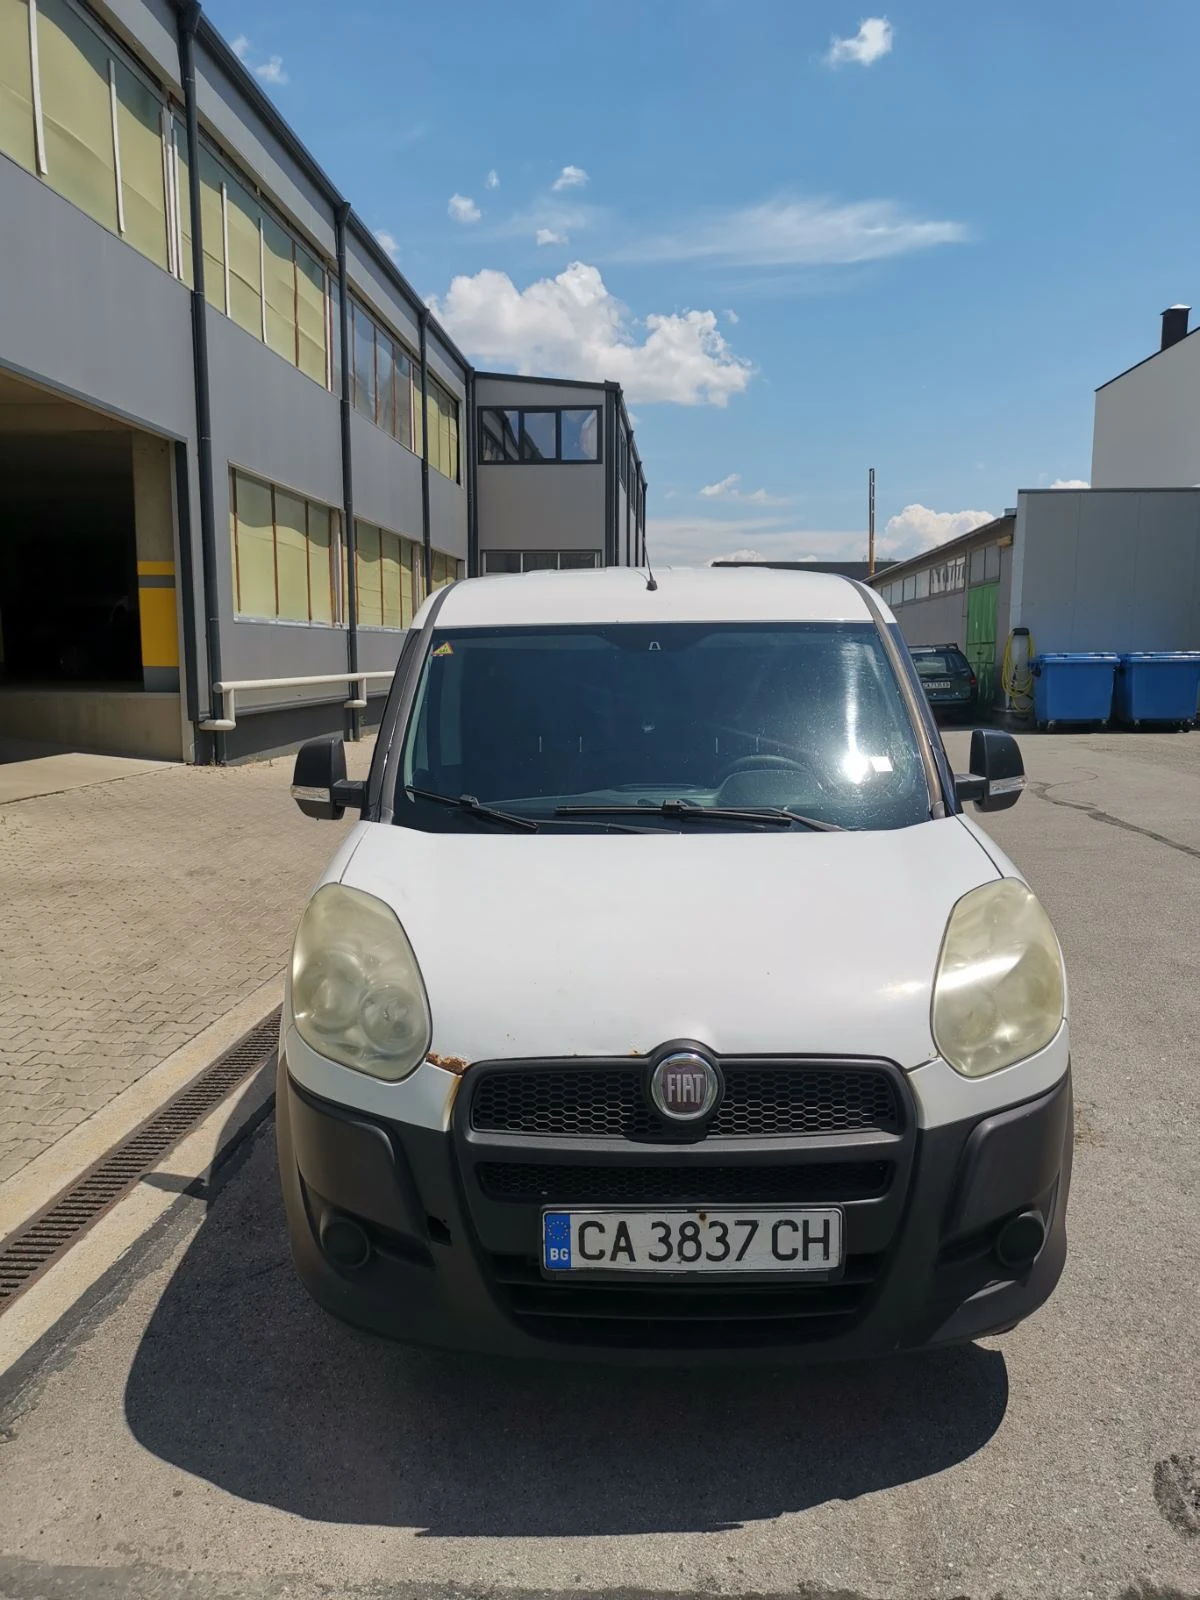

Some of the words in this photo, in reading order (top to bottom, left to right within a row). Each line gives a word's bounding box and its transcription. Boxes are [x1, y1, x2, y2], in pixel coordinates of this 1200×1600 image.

[667, 1073, 704, 1103] FIAT
[549, 1248, 569, 1261] BG
[578, 1220, 637, 1262] CA
[648, 1219, 760, 1262] 3837
[771, 1218, 830, 1262] CH
